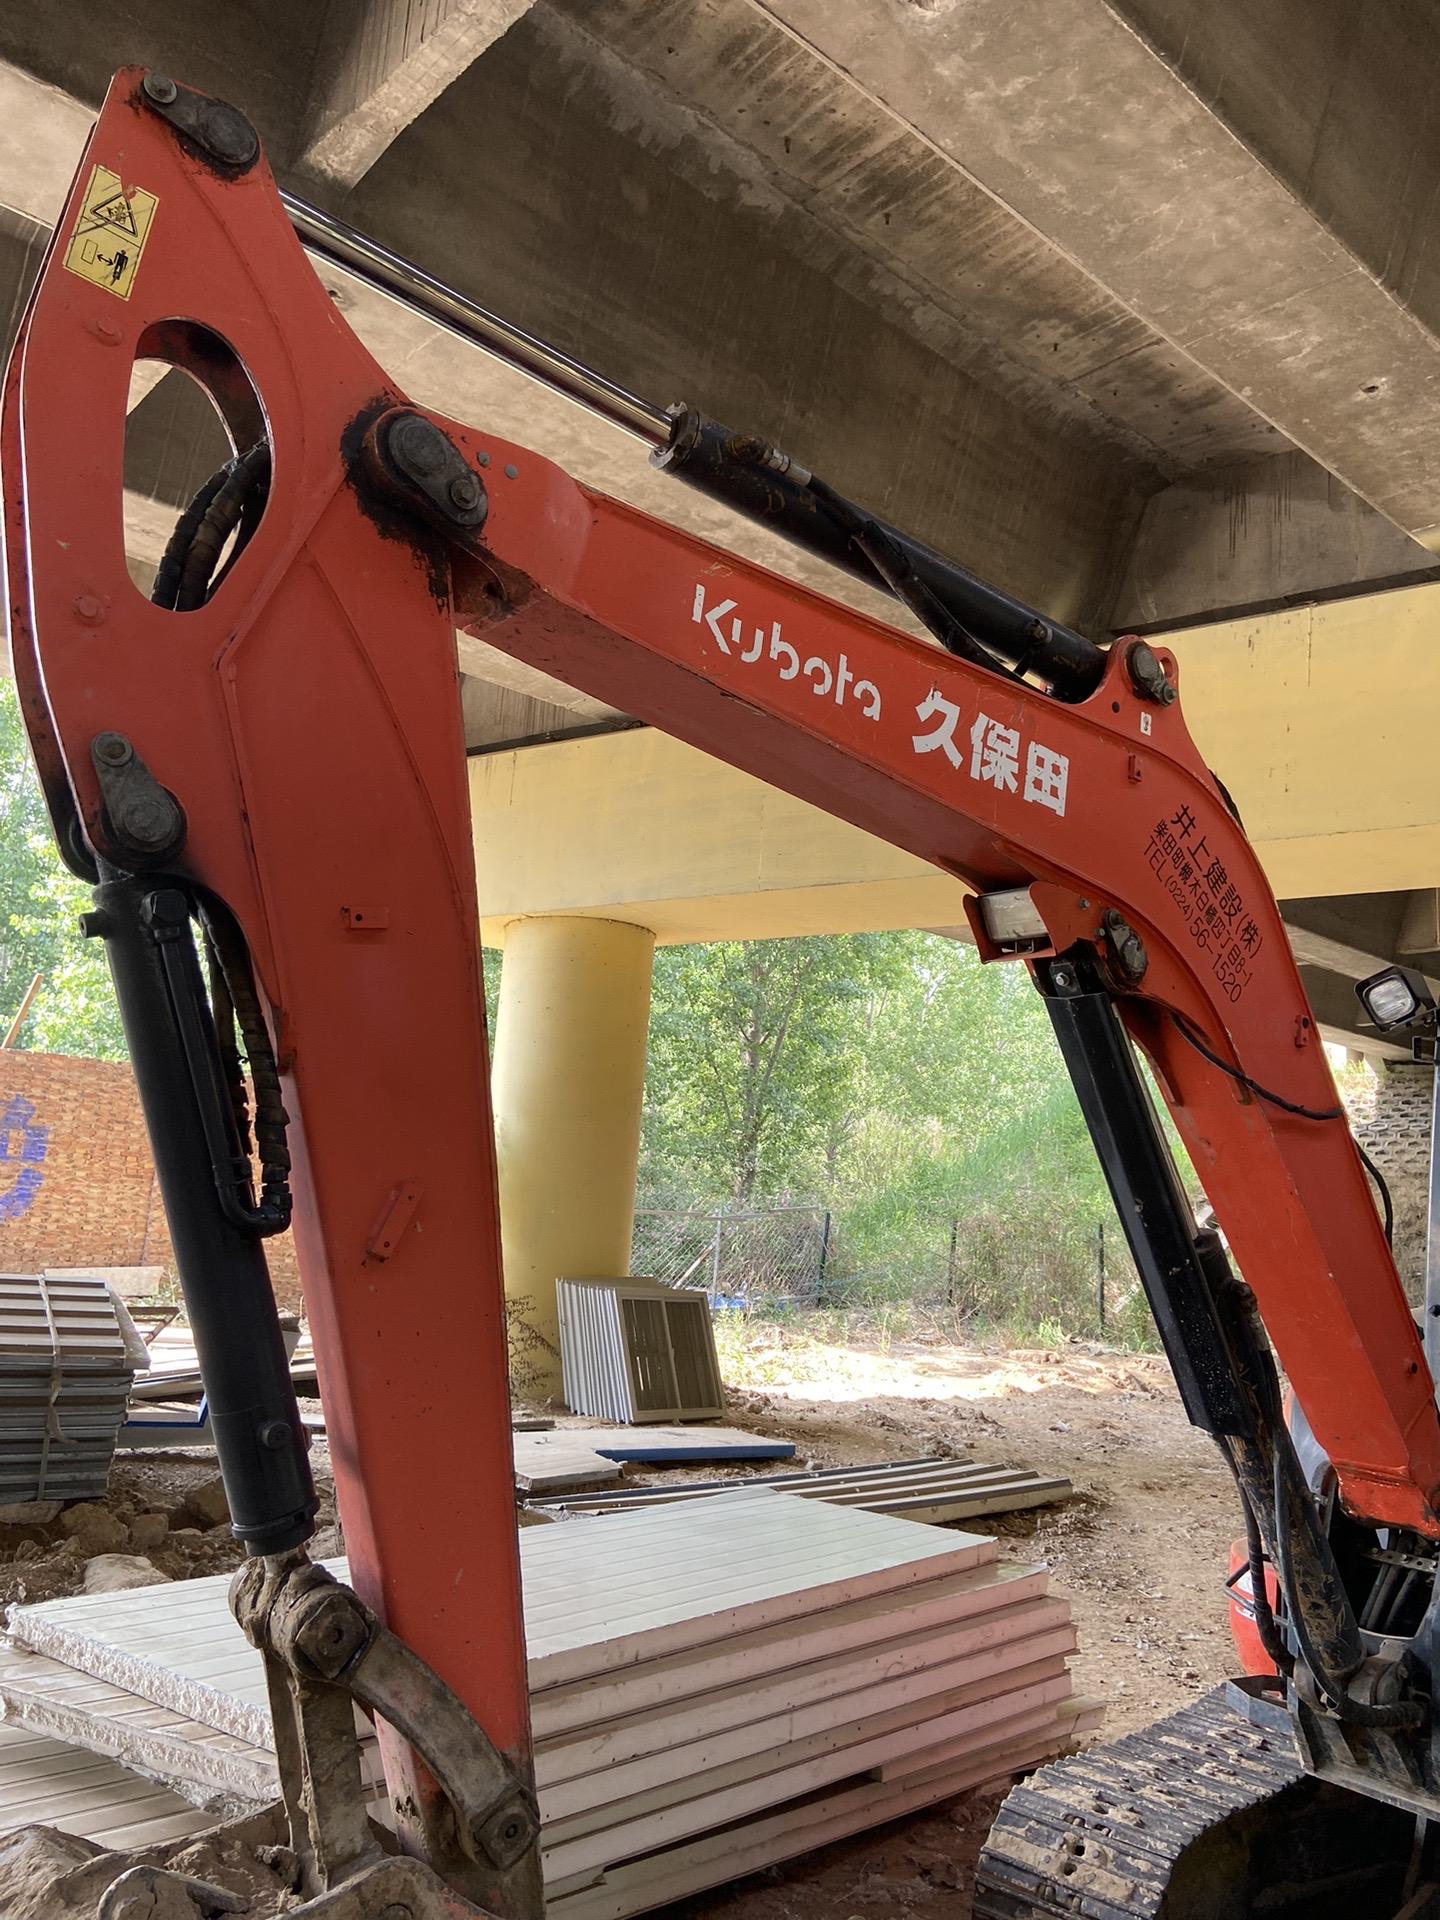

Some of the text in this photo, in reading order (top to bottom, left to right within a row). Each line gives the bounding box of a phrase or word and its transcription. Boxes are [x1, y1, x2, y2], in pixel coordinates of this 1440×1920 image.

[692, 583, 1070, 817] Kubota 久保田
